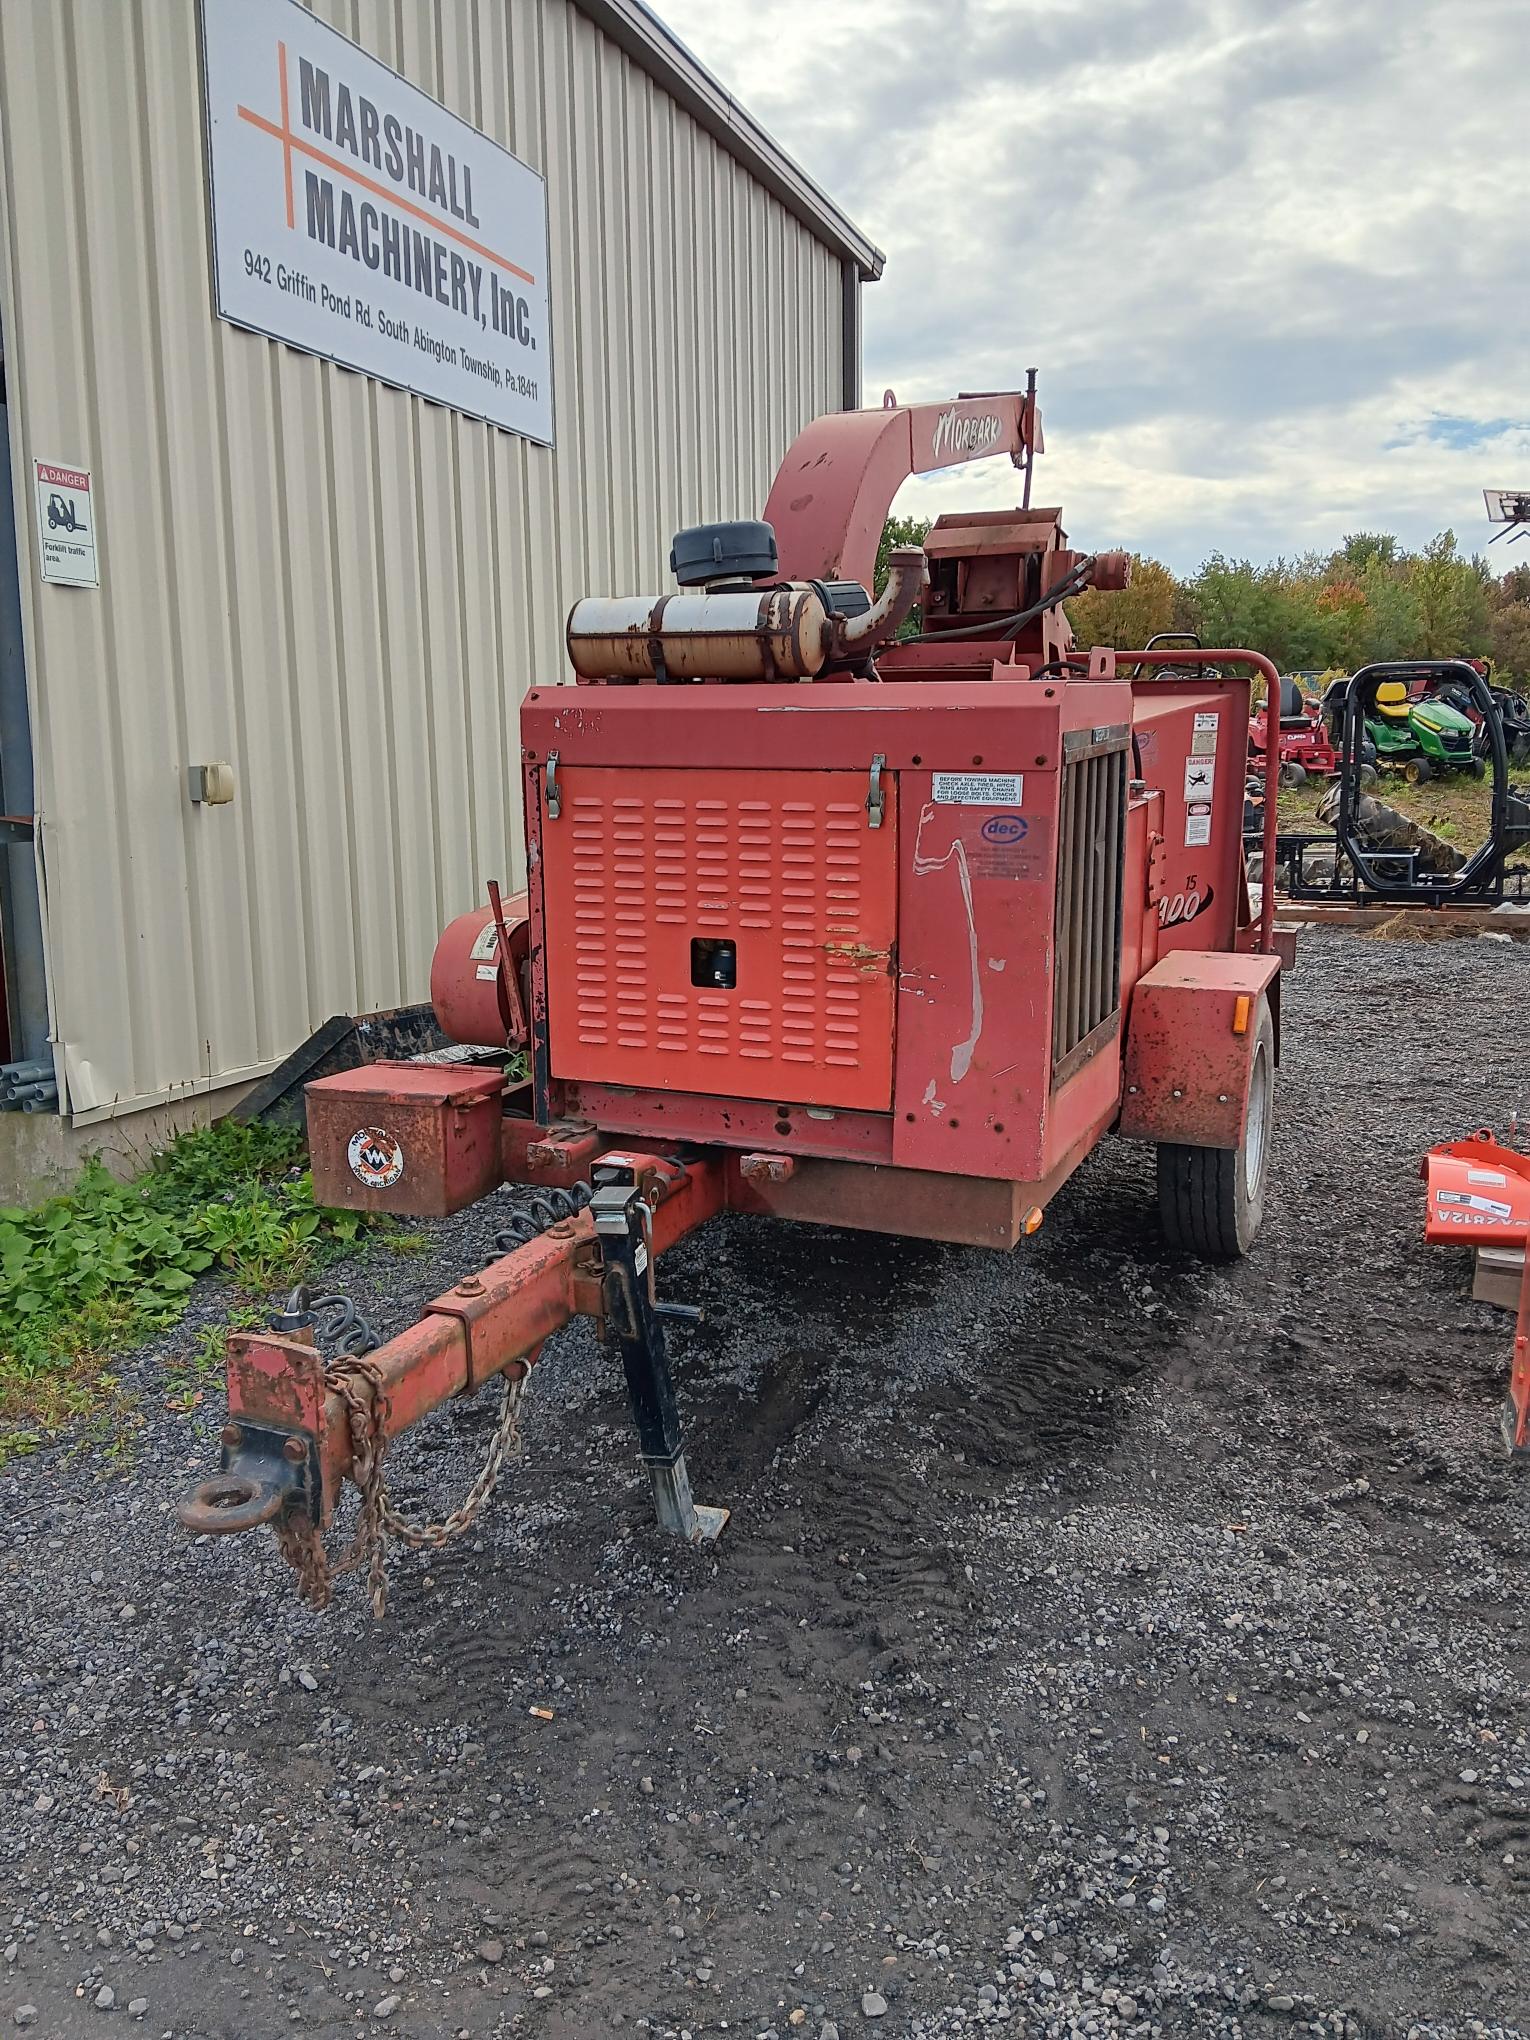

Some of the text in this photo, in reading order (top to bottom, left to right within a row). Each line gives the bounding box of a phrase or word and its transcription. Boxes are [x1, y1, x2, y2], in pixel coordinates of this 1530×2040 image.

[299, 56, 480, 229] MARSHALL
[305, 170, 537, 351] MACHINERY, Inc.
[244, 248, 538, 402] 942 Griffin Pond Rd. South Abington Township, Pa.18411
[932, 405, 1000, 459] MORBARK
[49, 469, 86, 487] DANGER
[45, 542, 86, 556] Forklift traffic
[987, 821, 1019, 834] dec
[1185, 874, 1198, 890] 15
